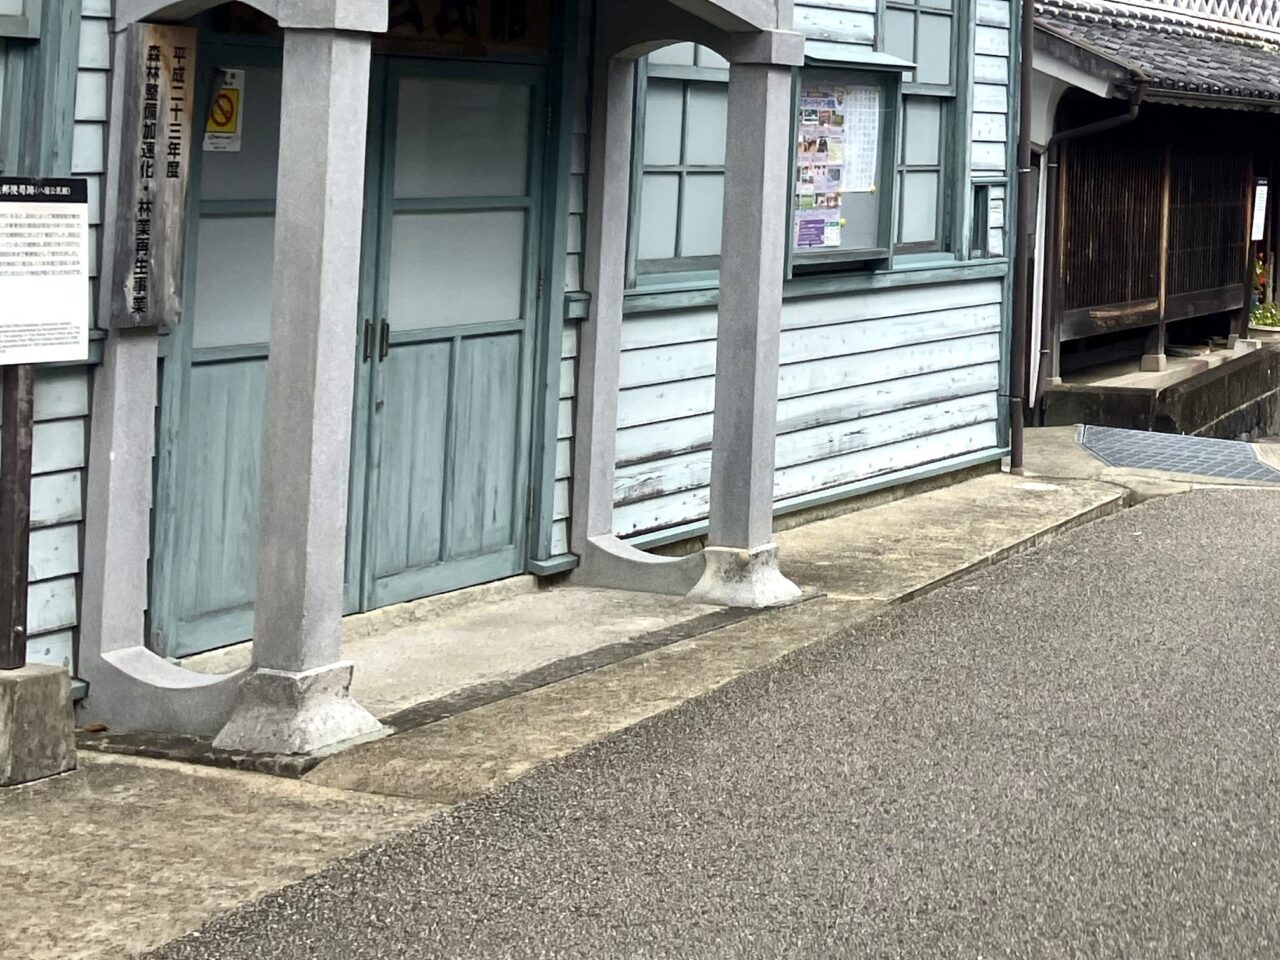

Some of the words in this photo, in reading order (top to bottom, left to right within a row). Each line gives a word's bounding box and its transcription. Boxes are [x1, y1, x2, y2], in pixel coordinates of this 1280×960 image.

[131, 44, 161, 314] 森林整備加速化・林業再生事業
[166, 46, 187, 179] 平成二十三年度
